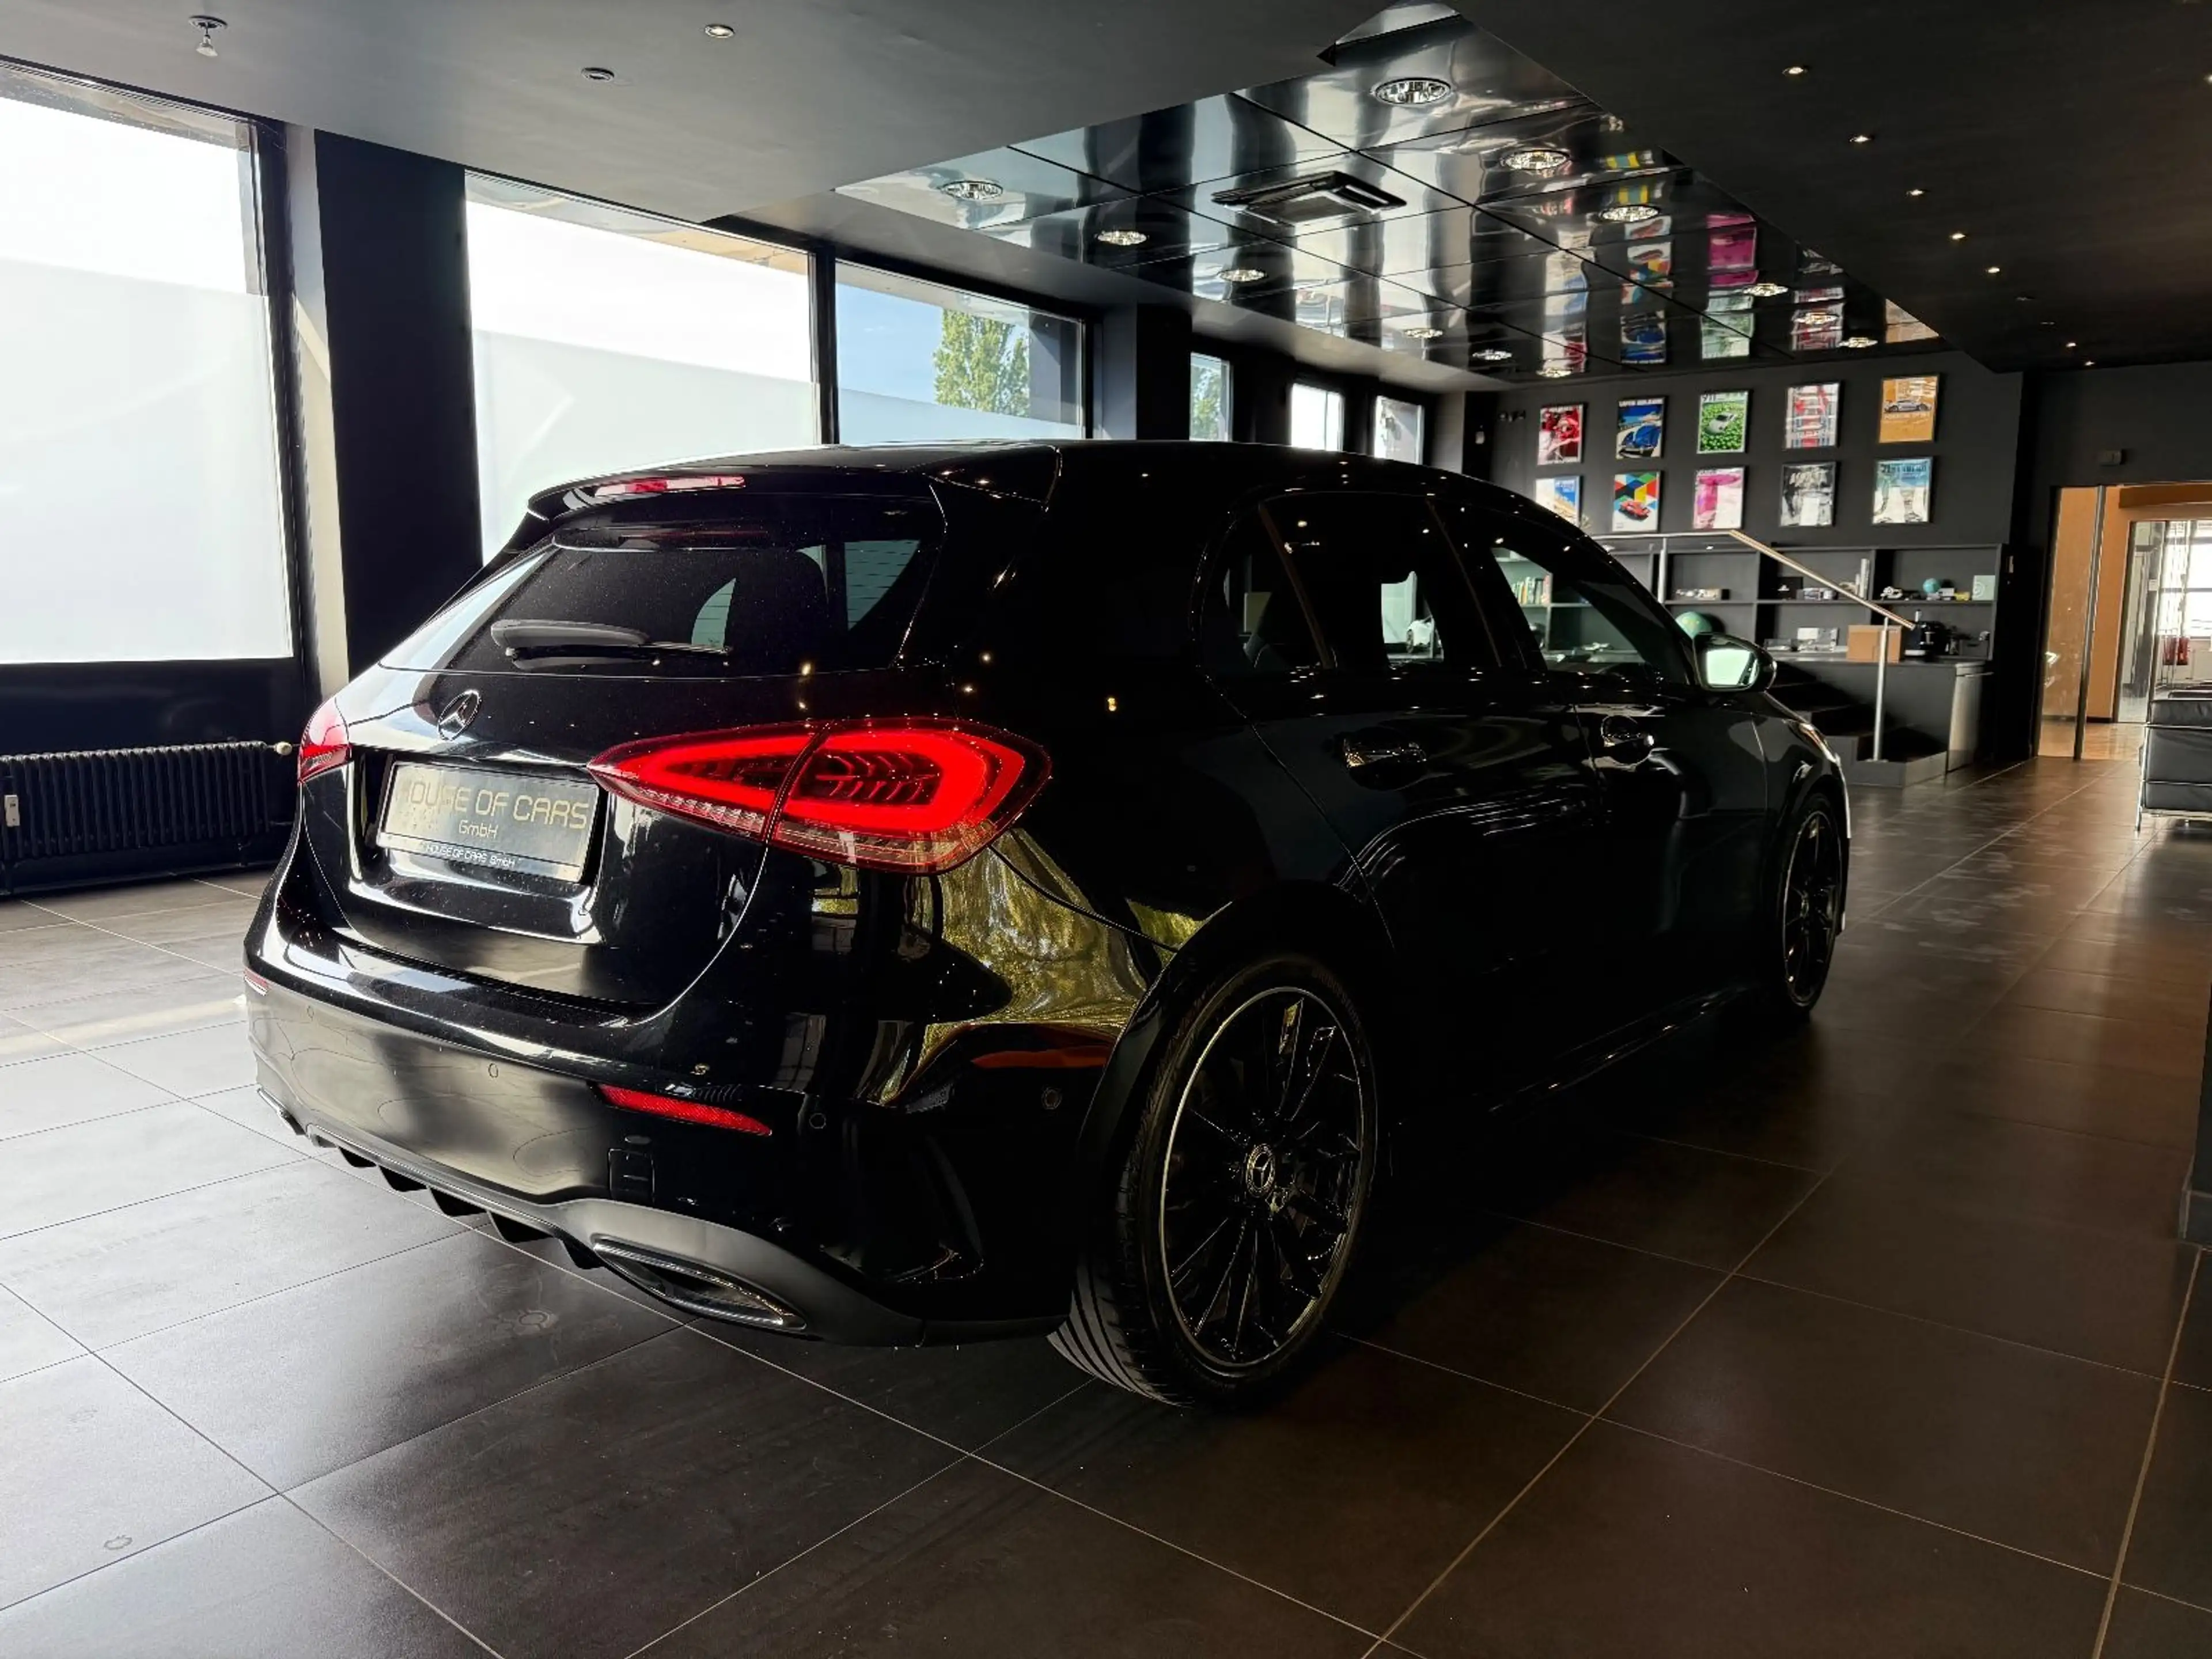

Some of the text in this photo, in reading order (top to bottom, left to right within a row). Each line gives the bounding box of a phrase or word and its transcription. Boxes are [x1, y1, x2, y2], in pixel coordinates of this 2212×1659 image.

[476, 789, 509, 816] OF
[513, 795, 589, 829] CARS
[459, 820, 499, 838] GmbH
